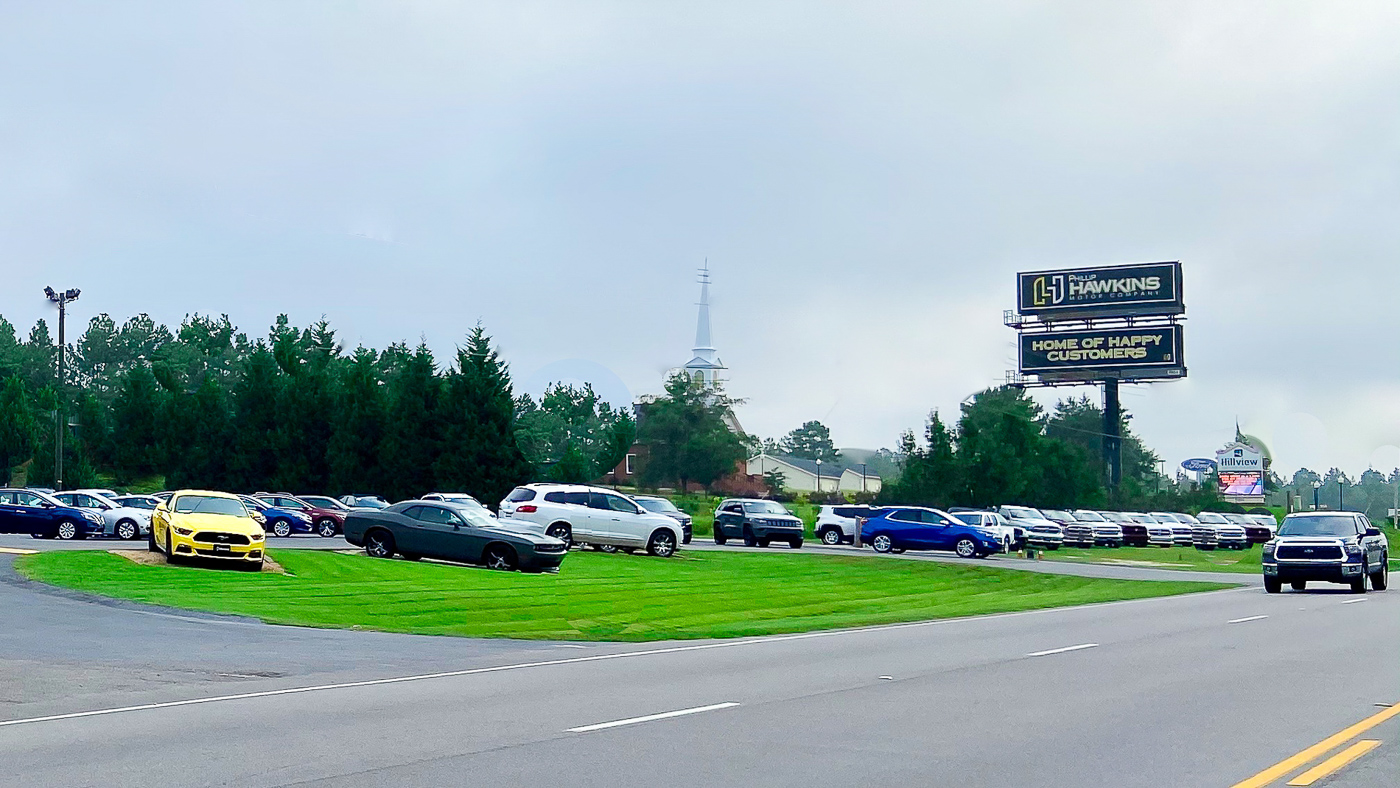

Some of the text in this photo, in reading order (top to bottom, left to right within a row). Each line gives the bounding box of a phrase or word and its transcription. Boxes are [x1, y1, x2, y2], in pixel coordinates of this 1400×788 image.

[1069, 276, 1160, 295] HAWKINS
[1032, 335, 1162, 351] HOME OF HAPPY
[1047, 347, 1147, 361] CUSTOMERS
[1221, 458, 1258, 466] Hillview
